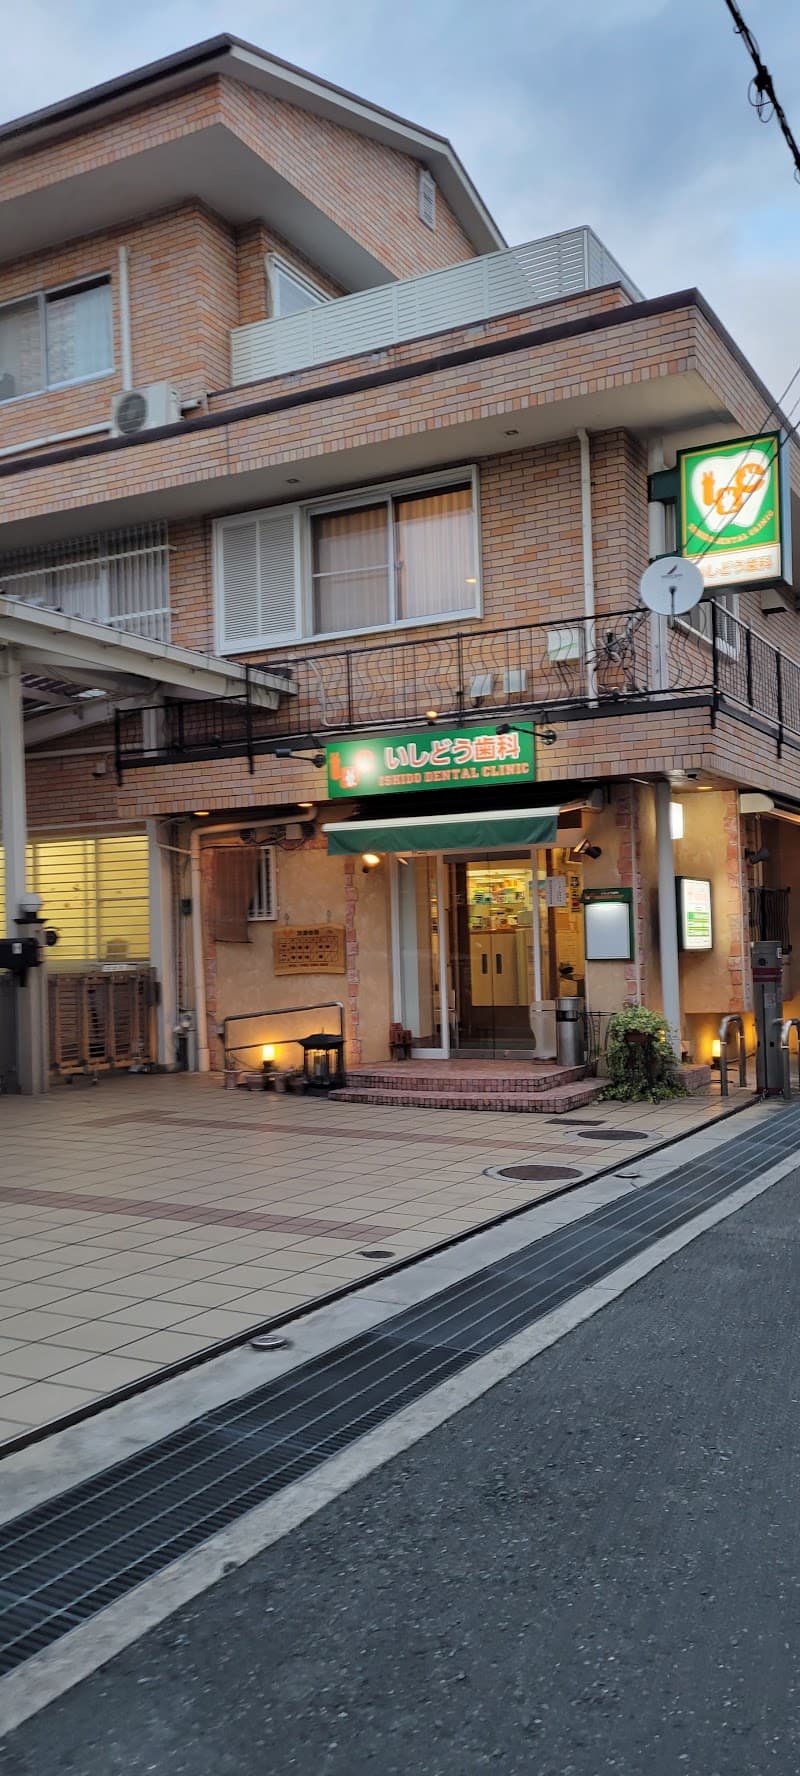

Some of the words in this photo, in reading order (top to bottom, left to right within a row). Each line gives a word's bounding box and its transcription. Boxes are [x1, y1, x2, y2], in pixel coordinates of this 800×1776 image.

[384, 733, 519, 769] いしどう歯科
[379, 773, 421, 786] ISHIDO
[424, 768, 479, 782] DENTAL
[482, 763, 529, 777] CLINIC
